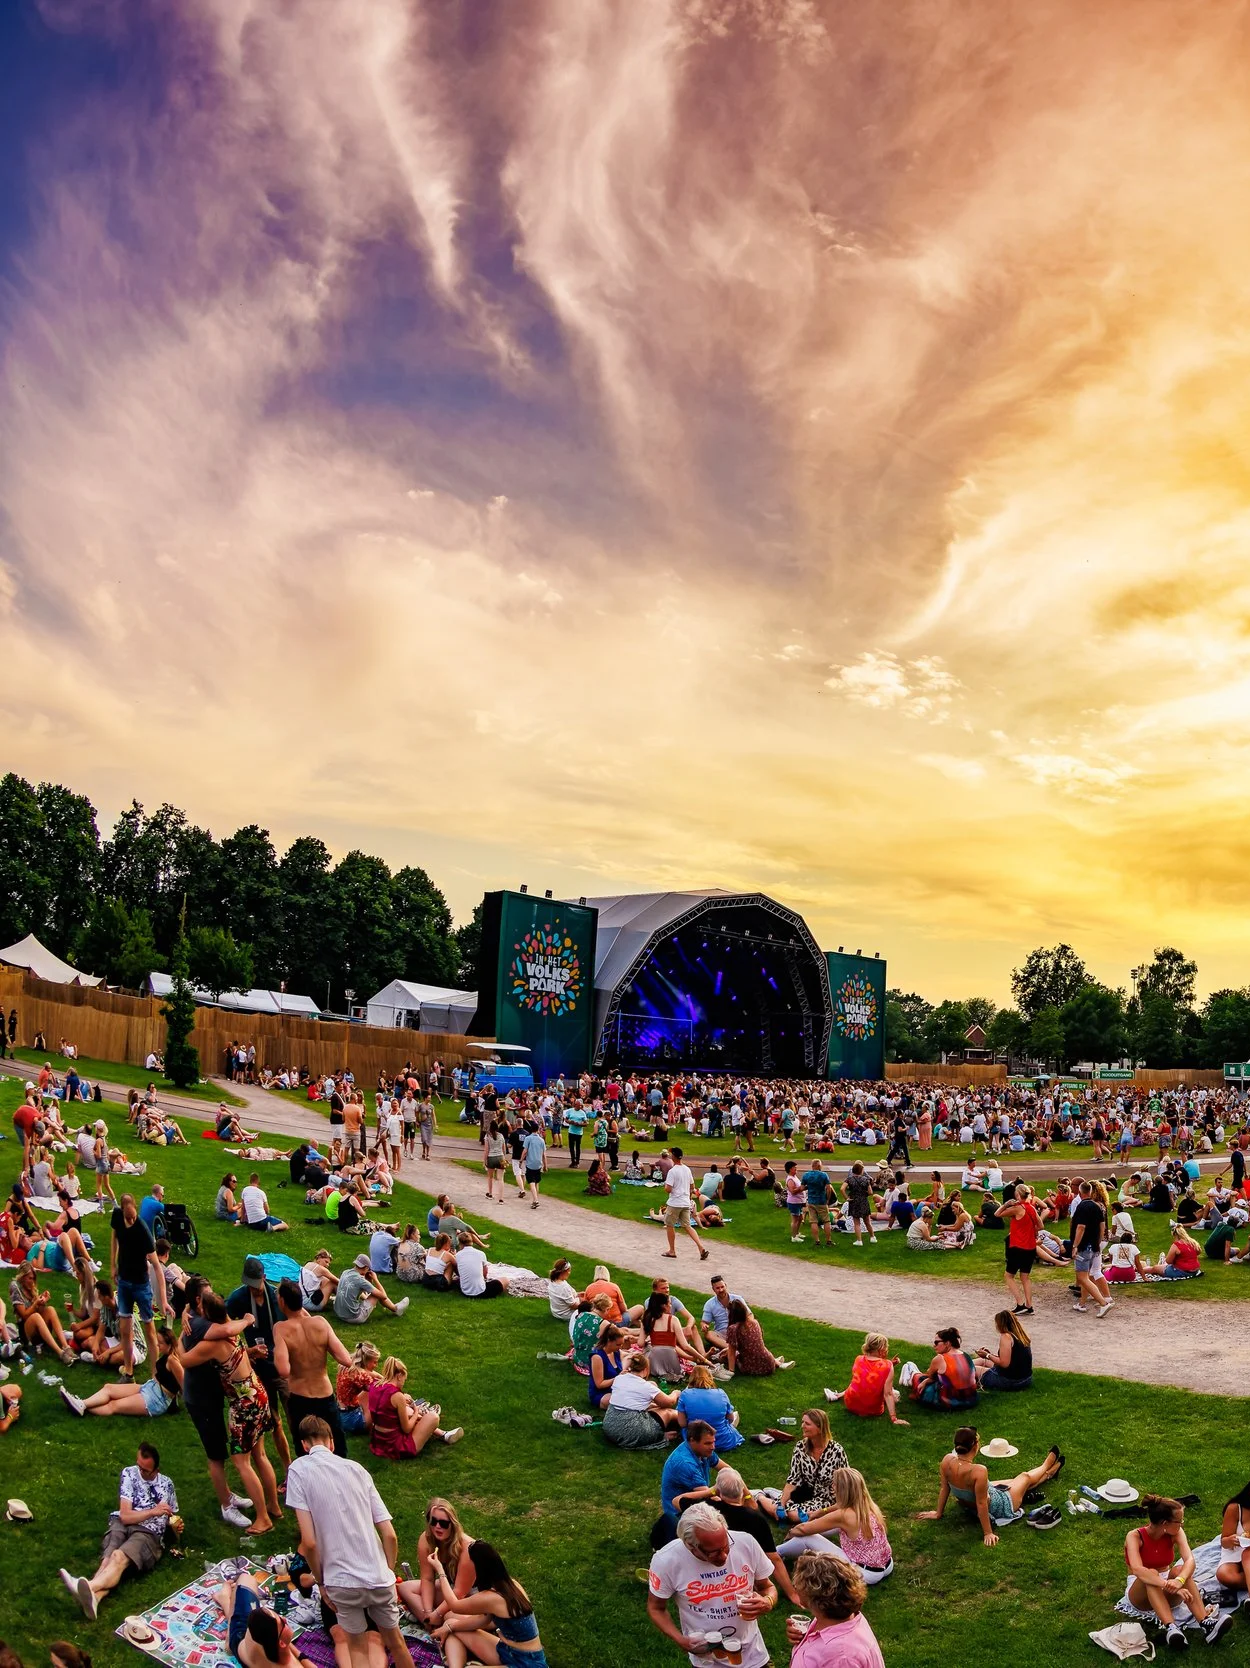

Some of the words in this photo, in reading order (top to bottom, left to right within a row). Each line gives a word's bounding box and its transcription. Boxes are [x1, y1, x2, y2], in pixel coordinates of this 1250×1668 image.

[535, 953, 544, 965] IN
[547, 955, 561, 967] HET
[526, 962, 570, 982] VOLKS
[529, 977, 566, 995] PARK
[844, 1003, 871, 1015] VOLKS
[846, 1013, 869, 1025] PARK
[700, 1568, 728, 1579] VINTAGE
